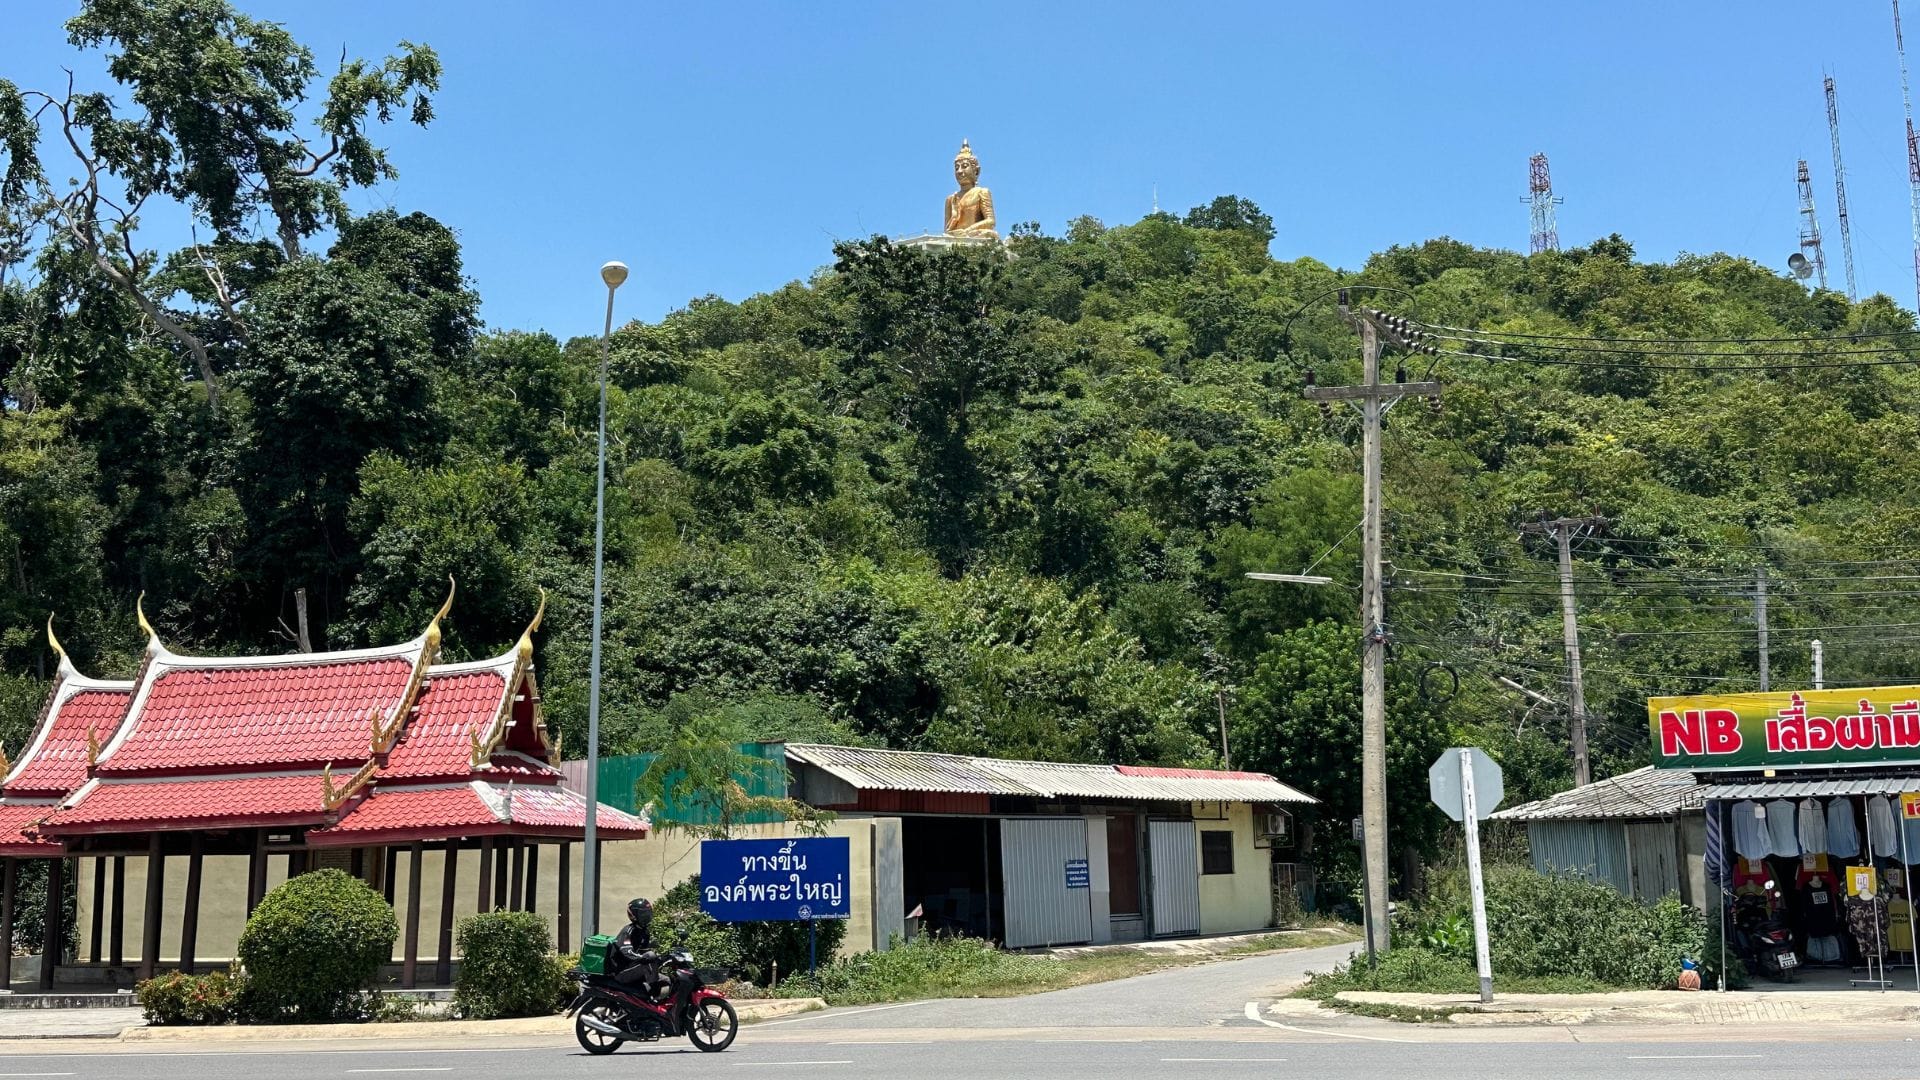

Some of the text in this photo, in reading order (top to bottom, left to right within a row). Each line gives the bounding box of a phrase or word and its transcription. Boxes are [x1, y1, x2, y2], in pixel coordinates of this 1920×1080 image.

[1659, 709, 1743, 756] NB
[742, 840, 807, 872] ทางขึ้น
[704, 873, 842, 906] องค์พระใหญ่
